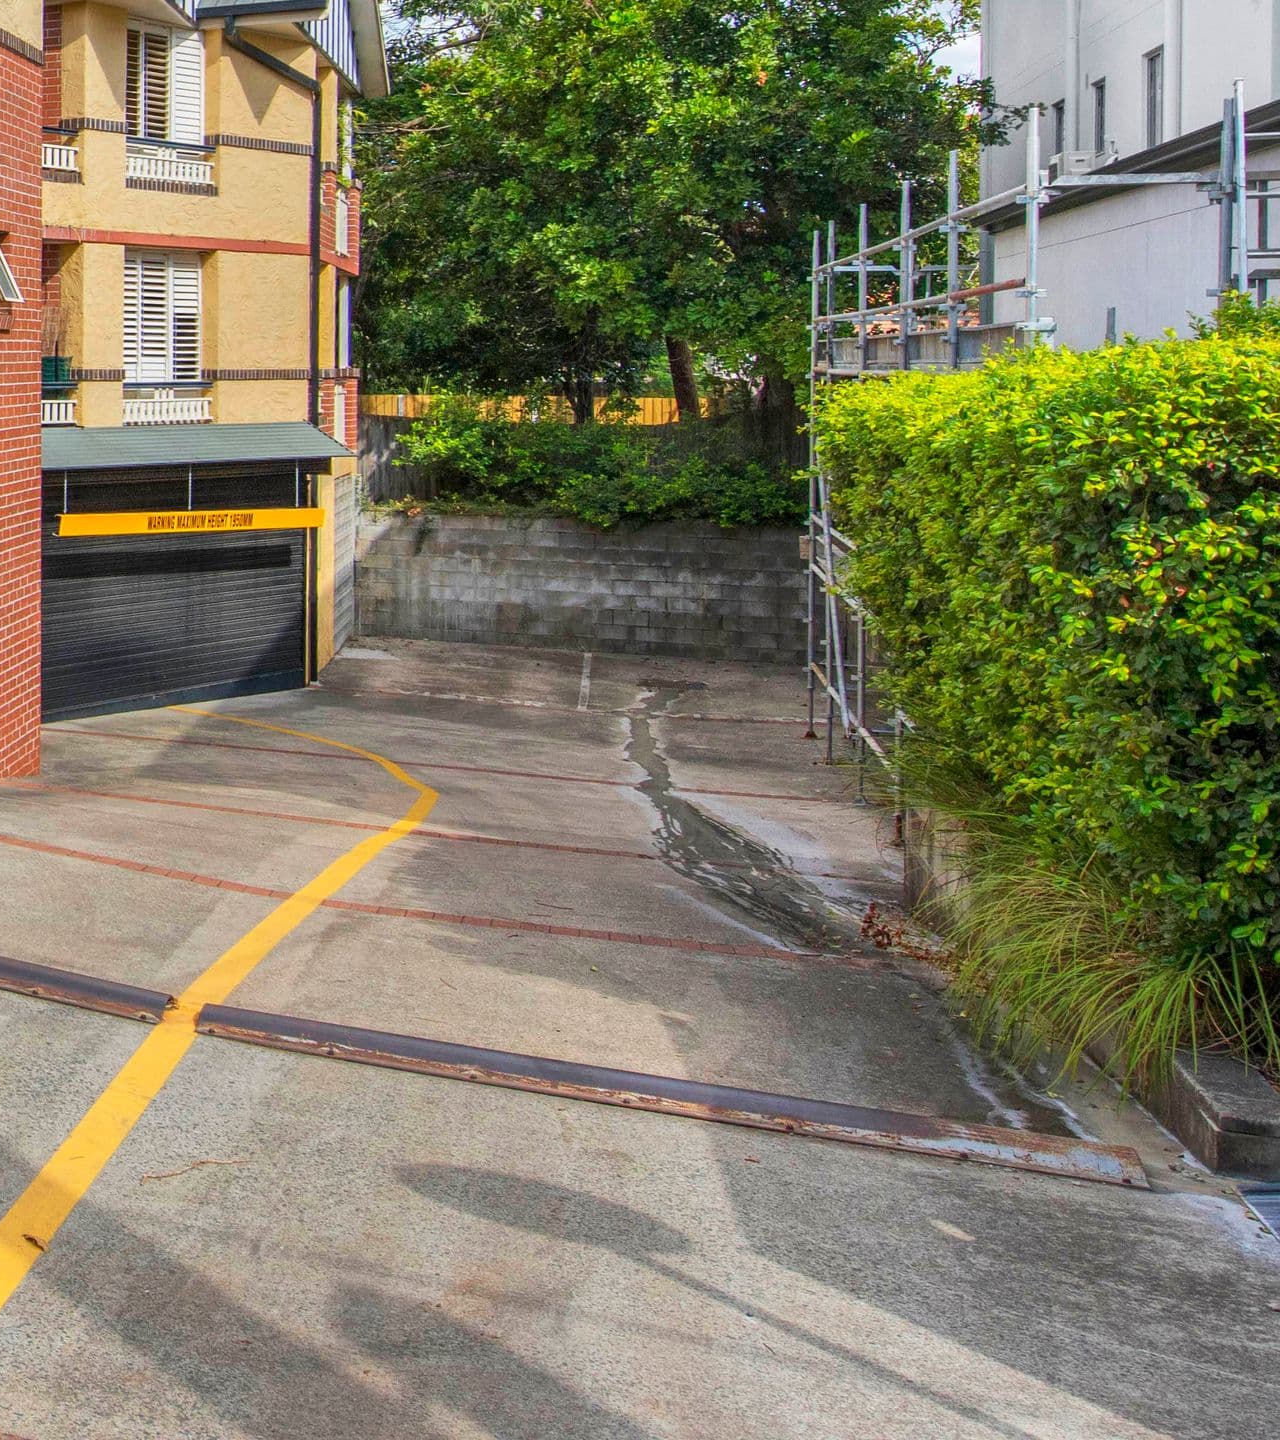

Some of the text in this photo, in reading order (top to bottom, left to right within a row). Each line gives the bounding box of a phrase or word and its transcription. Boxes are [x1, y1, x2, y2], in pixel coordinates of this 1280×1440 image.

[147, 515, 176, 530] WARNING
[177, 514, 207, 529] MAXIMUM
[207, 513, 229, 528] HEIGHT
